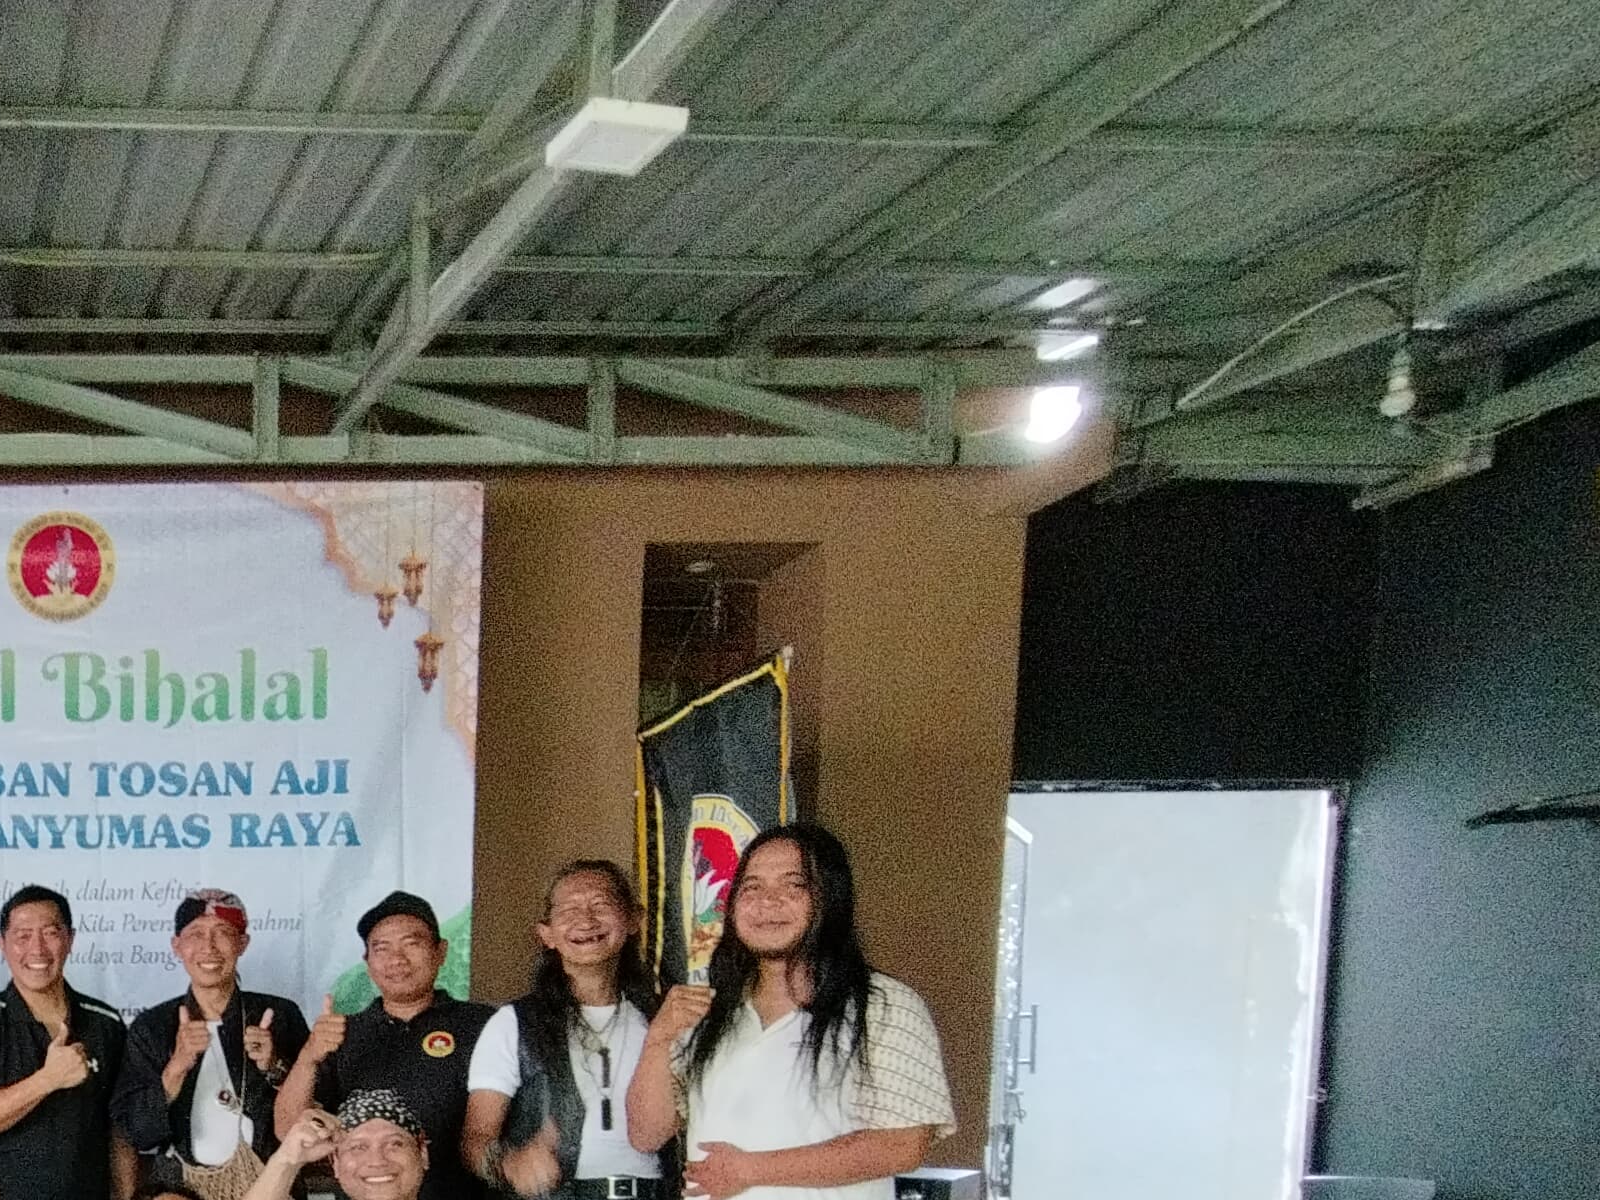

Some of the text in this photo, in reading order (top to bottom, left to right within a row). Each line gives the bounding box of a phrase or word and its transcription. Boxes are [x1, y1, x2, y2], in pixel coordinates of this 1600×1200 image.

[41, 647, 329, 729] Bihalal
[89, 760, 254, 798] TOSAN
[269, 759, 351, 796] AJI
[228, 811, 362, 848] RAYA
[75, 878, 135, 902] dalam
[78, 912, 117, 933] Kita
[67, 941, 124, 972] udaya
